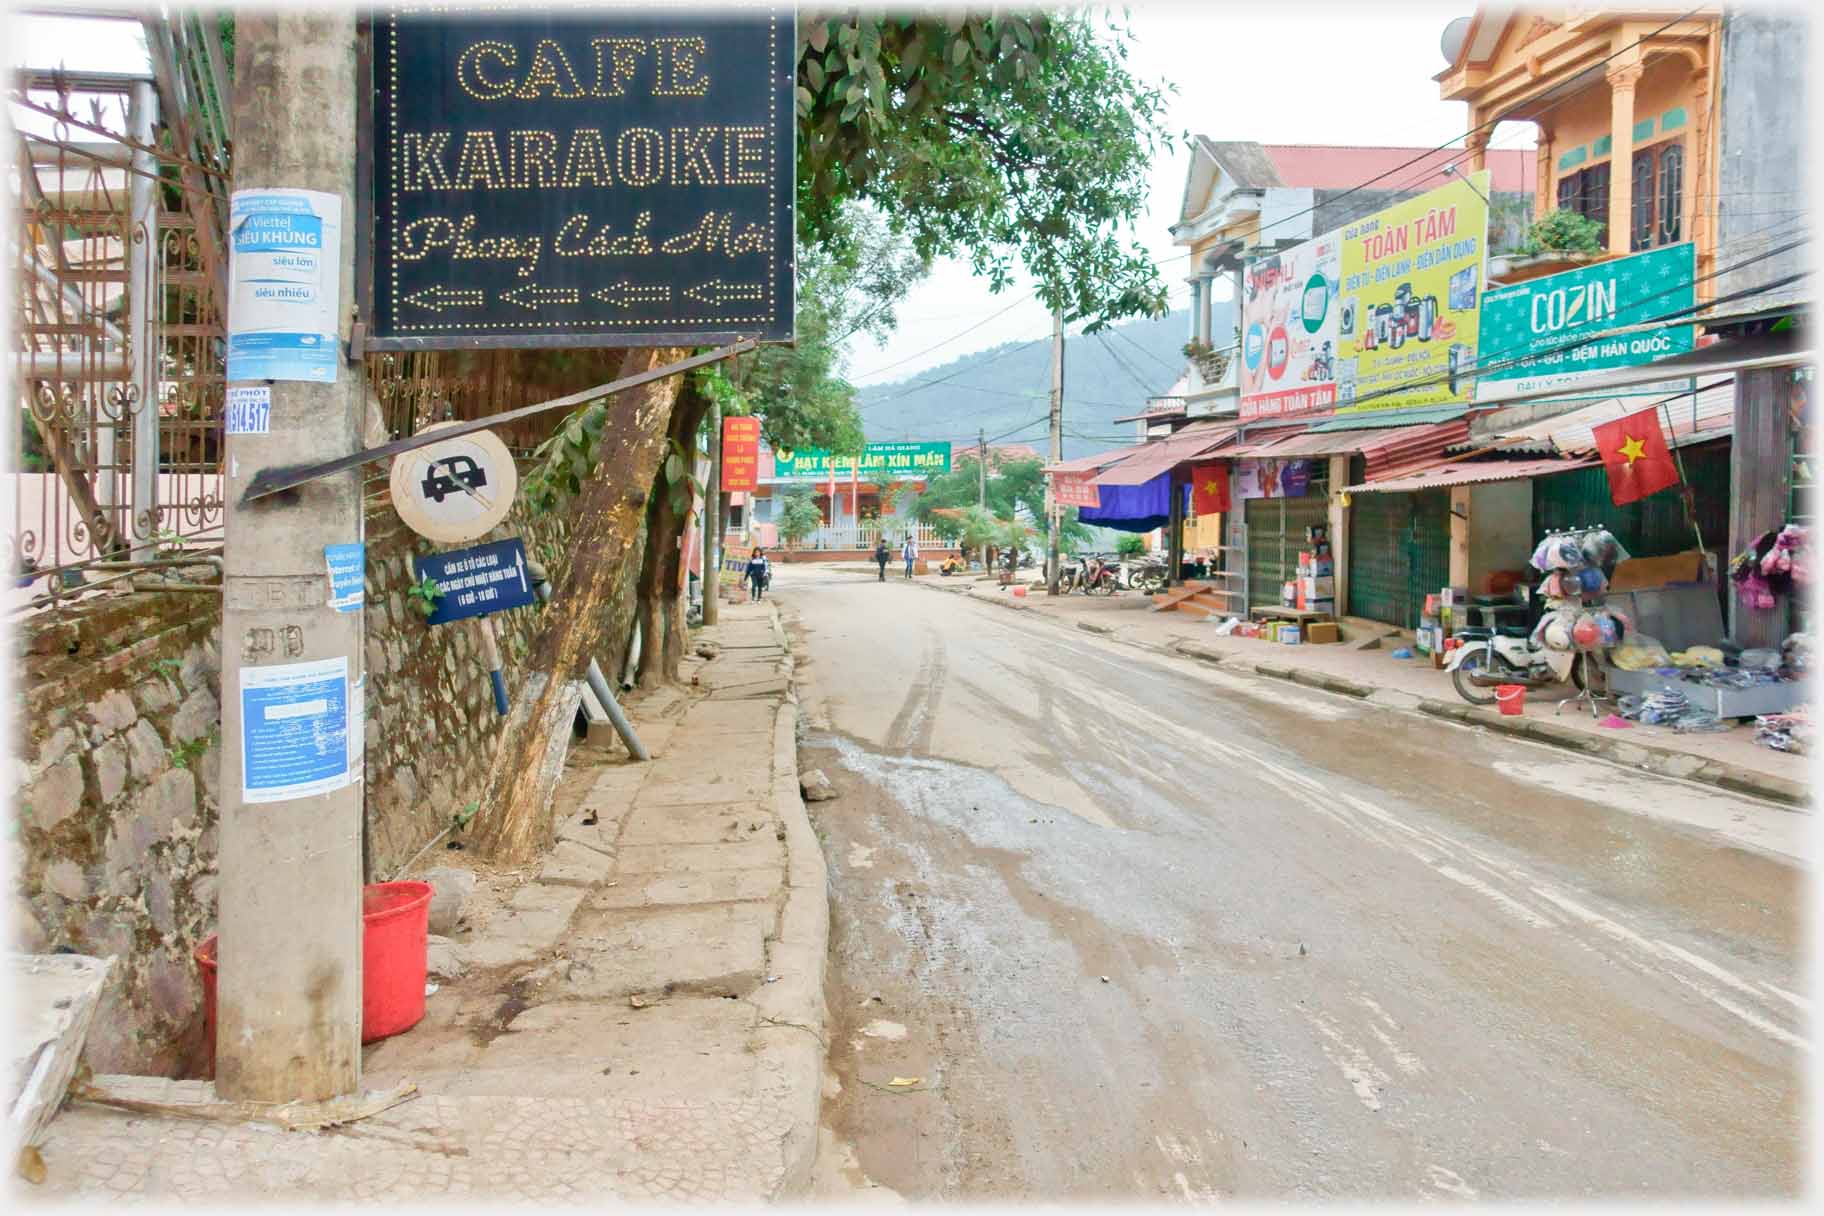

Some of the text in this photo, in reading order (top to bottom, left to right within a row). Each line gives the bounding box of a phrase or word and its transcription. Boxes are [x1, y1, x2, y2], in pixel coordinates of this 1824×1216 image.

[456, 36, 710, 100] CAFE
[403, 127, 767, 191] KARAOKE
[400, 214, 541, 277] Phong
[1361, 206, 1457, 263] TOÀN TÂM
[1530, 278, 1617, 334] COZIN
[1631, 330, 1671, 354] QUỐC
[888, 451, 911, 468] XÍN
